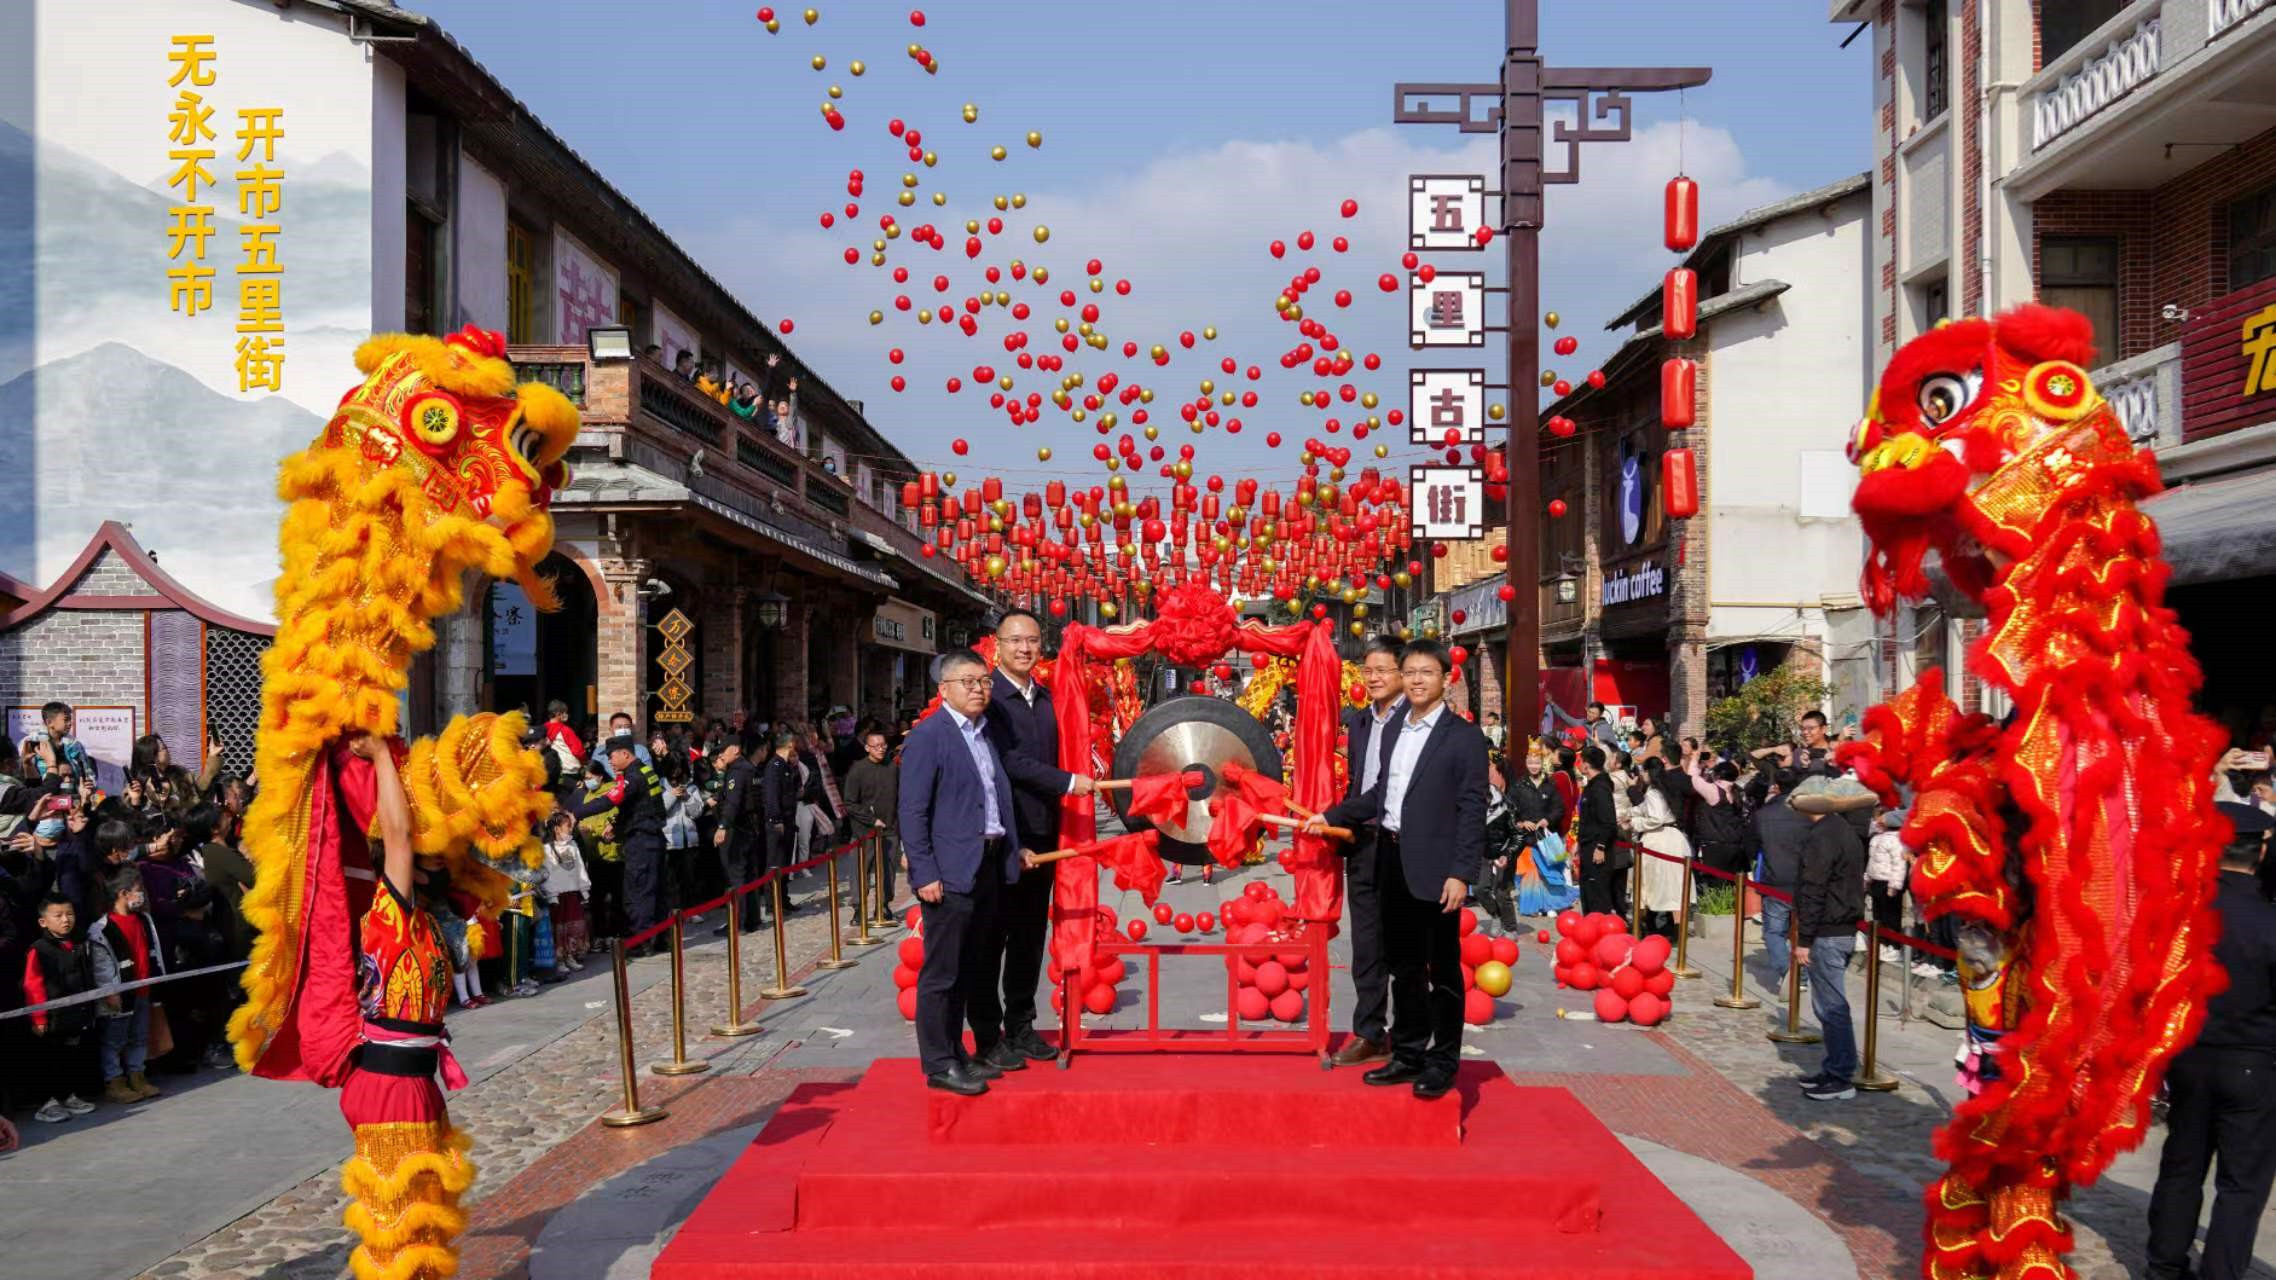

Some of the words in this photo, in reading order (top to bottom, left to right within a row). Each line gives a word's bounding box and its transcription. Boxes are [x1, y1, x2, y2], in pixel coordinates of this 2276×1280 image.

[167, 34, 217, 317] 无永不开市
[235, 108, 285, 392] 开市五里街
[1427, 194, 1466, 524] 五里古街
[1602, 568, 1629, 606] luckin
[1630, 559, 1663, 601] coffee
